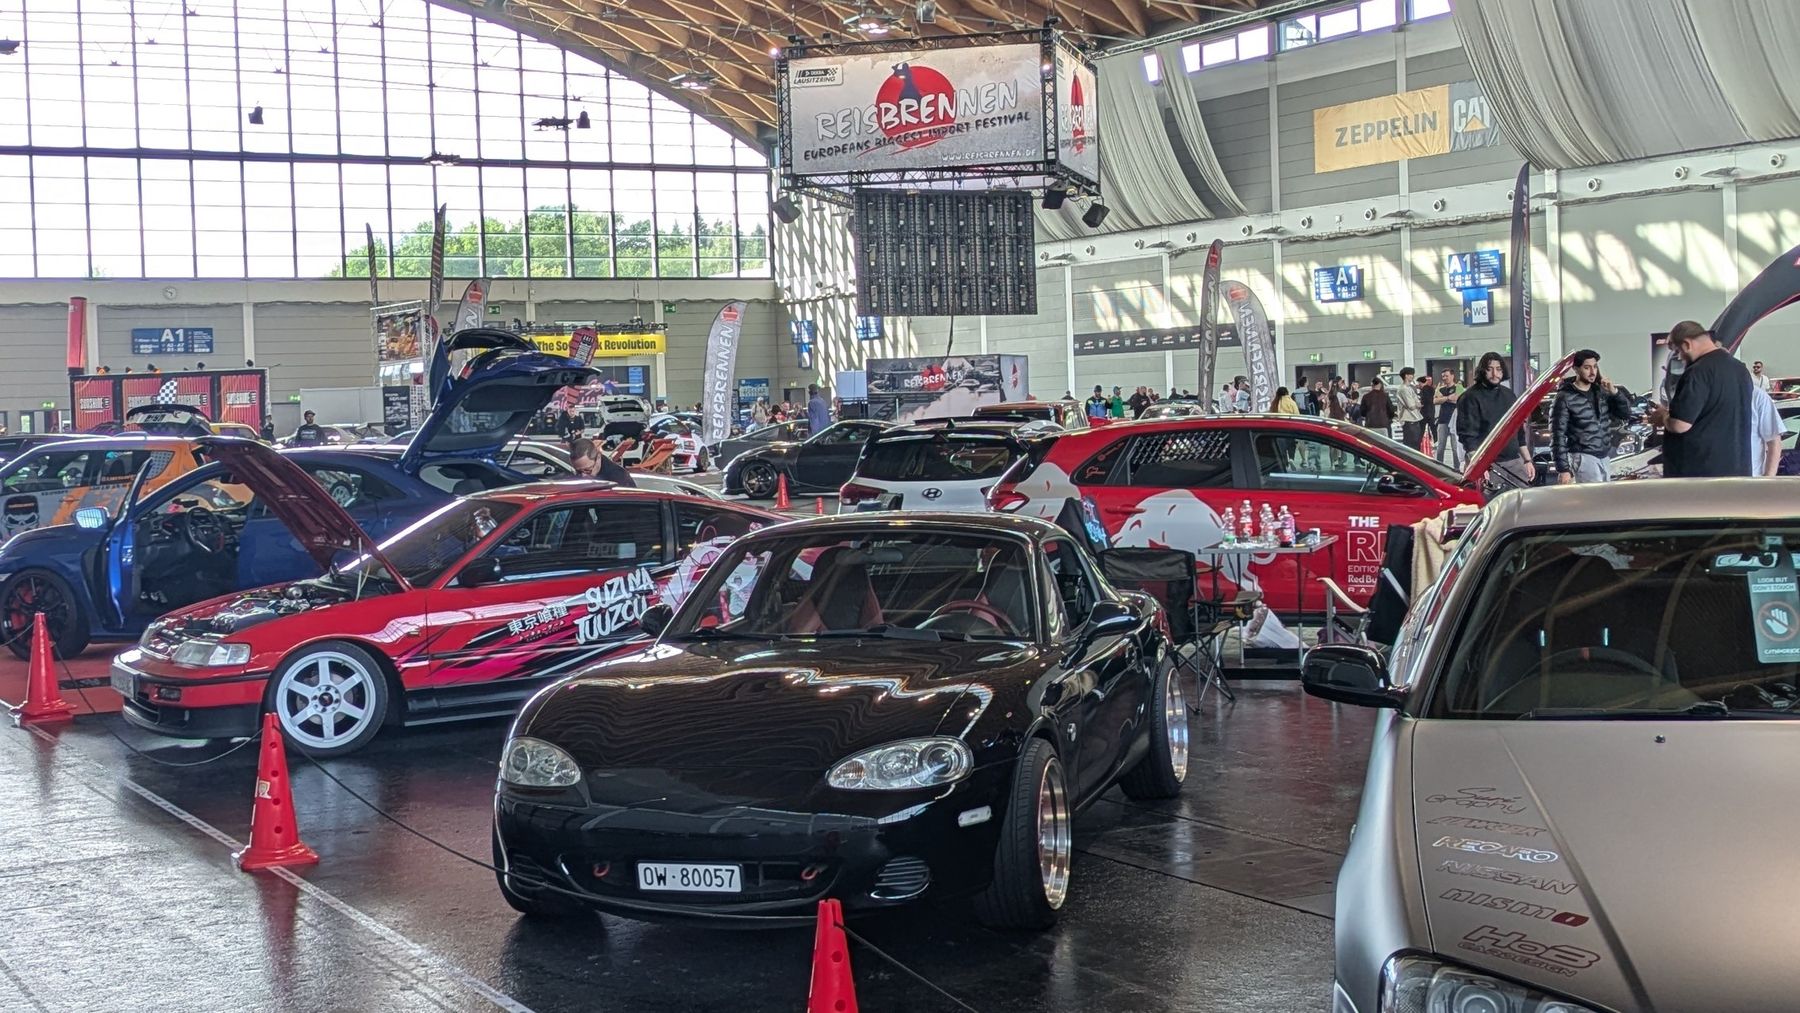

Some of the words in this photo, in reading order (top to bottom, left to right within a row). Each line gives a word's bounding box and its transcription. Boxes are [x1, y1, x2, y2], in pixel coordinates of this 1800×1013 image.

[816, 79, 1018, 141] REISBRENNEN
[1453, 96, 1491, 133] CAT
[803, 140, 870, 160] EUROPEANS
[875, 132, 923, 147] BIGGEST
[928, 121, 970, 138] IMPORT
[975, 112, 1031, 130] FESTIVAL
[1335, 111, 1438, 148] ZEPPELIN
[1449, 254, 1471, 273] A1
[1336, 267, 1357, 285] A1
[1472, 307, 1487, 316] WC
[161, 329, 184, 342] A1
[604, 340, 657, 350] Revolution
[712, 325, 734, 440] REISBRENNEN
[904, 370, 965, 388] REISBRENNEN
[1348, 516, 1379, 527] THE
[1348, 575, 1364, 583] Red
[680, 868, 735, 888] 80057
[1436, 860, 1579, 895] NISSAN
